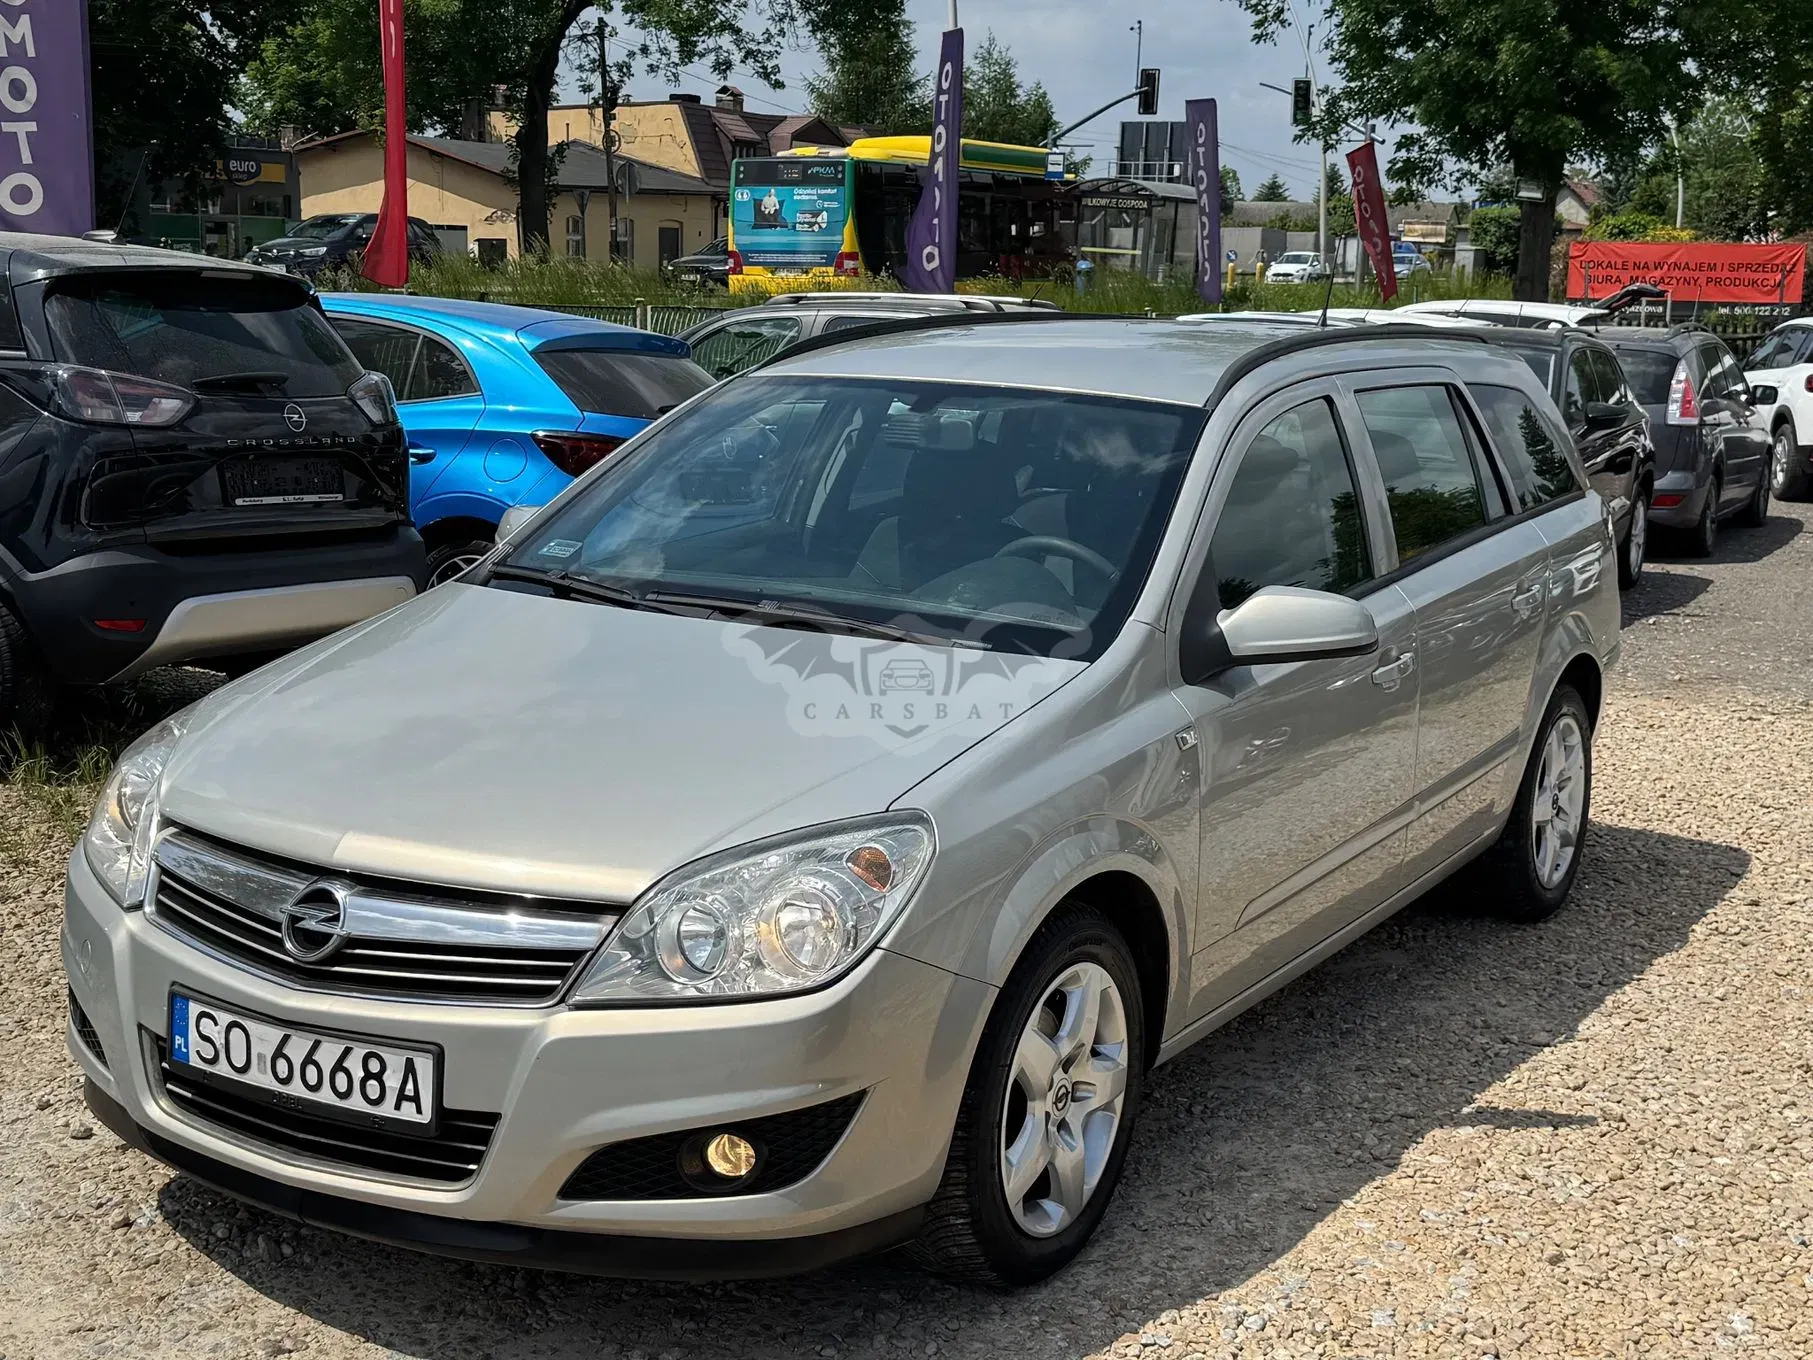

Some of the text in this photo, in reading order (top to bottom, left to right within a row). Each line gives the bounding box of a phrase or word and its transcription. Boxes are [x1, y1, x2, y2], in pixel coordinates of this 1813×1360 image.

[0, 0, 44, 215] MOTO
[230, 160, 257, 173] euro
[1117, 199, 1148, 208] GOSPODA
[1580, 260, 1629, 271] LOKALE
[1633, 261, 1650, 271] NA
[1653, 261, 1718, 273] WYNAJEM
[1720, 262, 1725, 273] I
[1755, 306, 1770, 315] 122
[227, 436, 355, 446] CROSSLAND
[175, 1035, 188, 1053] PL
[195, 1010, 423, 1115] SO 6668A
